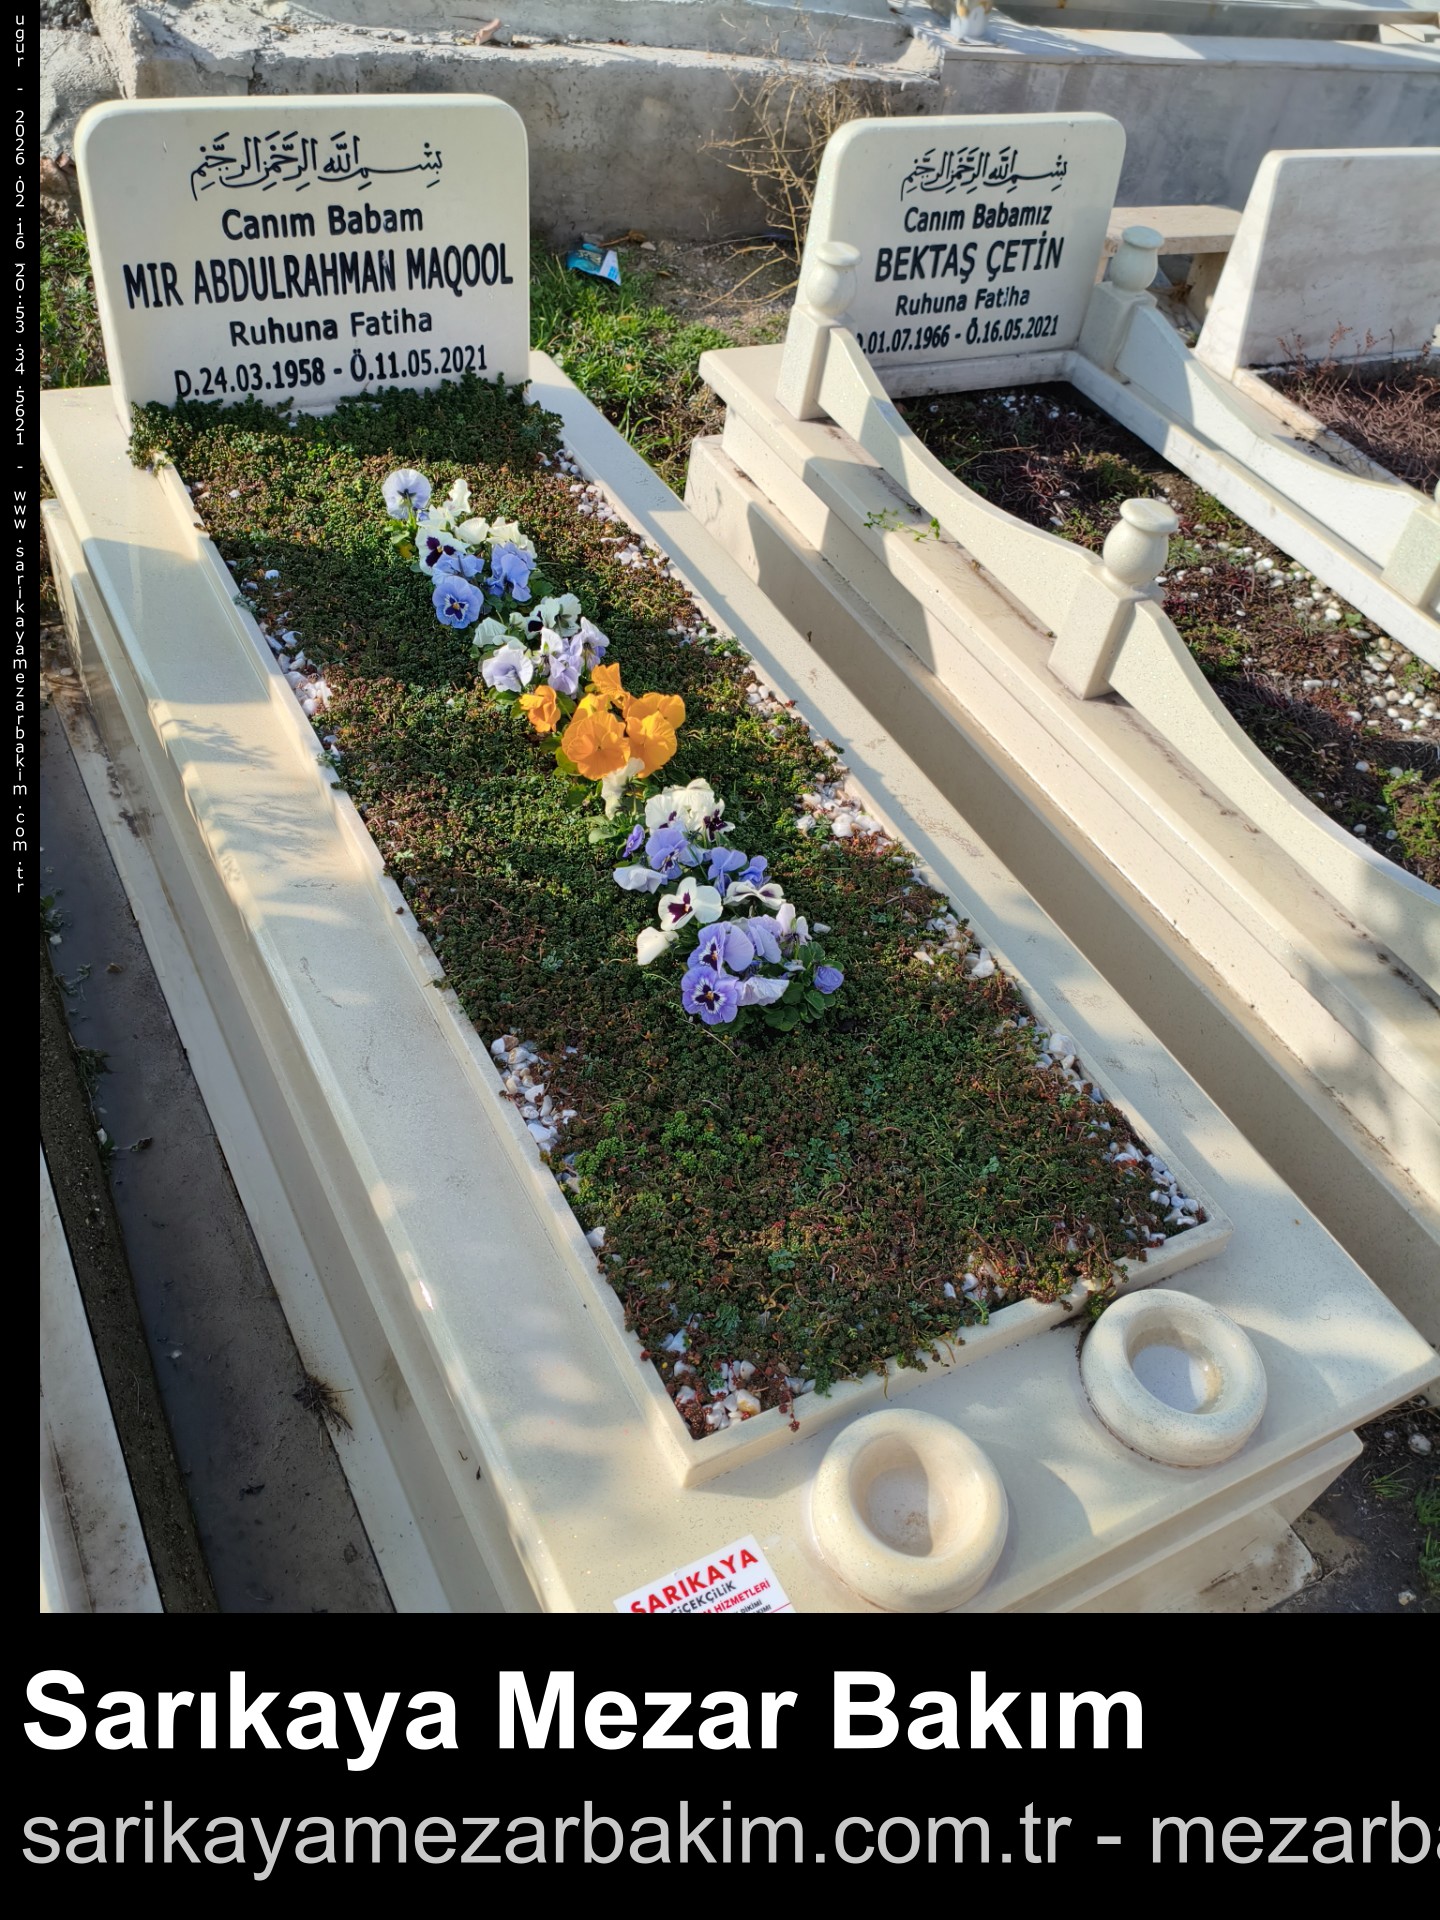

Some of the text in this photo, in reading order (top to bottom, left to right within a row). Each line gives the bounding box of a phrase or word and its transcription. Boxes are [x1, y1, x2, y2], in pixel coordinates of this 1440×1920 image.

[221, 203, 424, 241] Canım Babam
[904, 202, 1053, 233] Canım Babamız
[123, 242, 514, 310] MIR ABDULRAHMAN MAQOOL
[874, 229, 1065, 285] BEKTAŞ ÇETİN
[895, 285, 1031, 316] Ruhuna Fatiha
[229, 307, 433, 347] Ruhuna Fatiha
[966, 314, 1060, 345] Ö.16.05.2021
[174, 357, 326, 398] D.24.03.1958
[350, 345, 488, 383] Ö.11.05.2021
[630, 1548, 759, 1613] SARIKAYA
[713, 1577, 771, 1613] HİZMETLERİ
